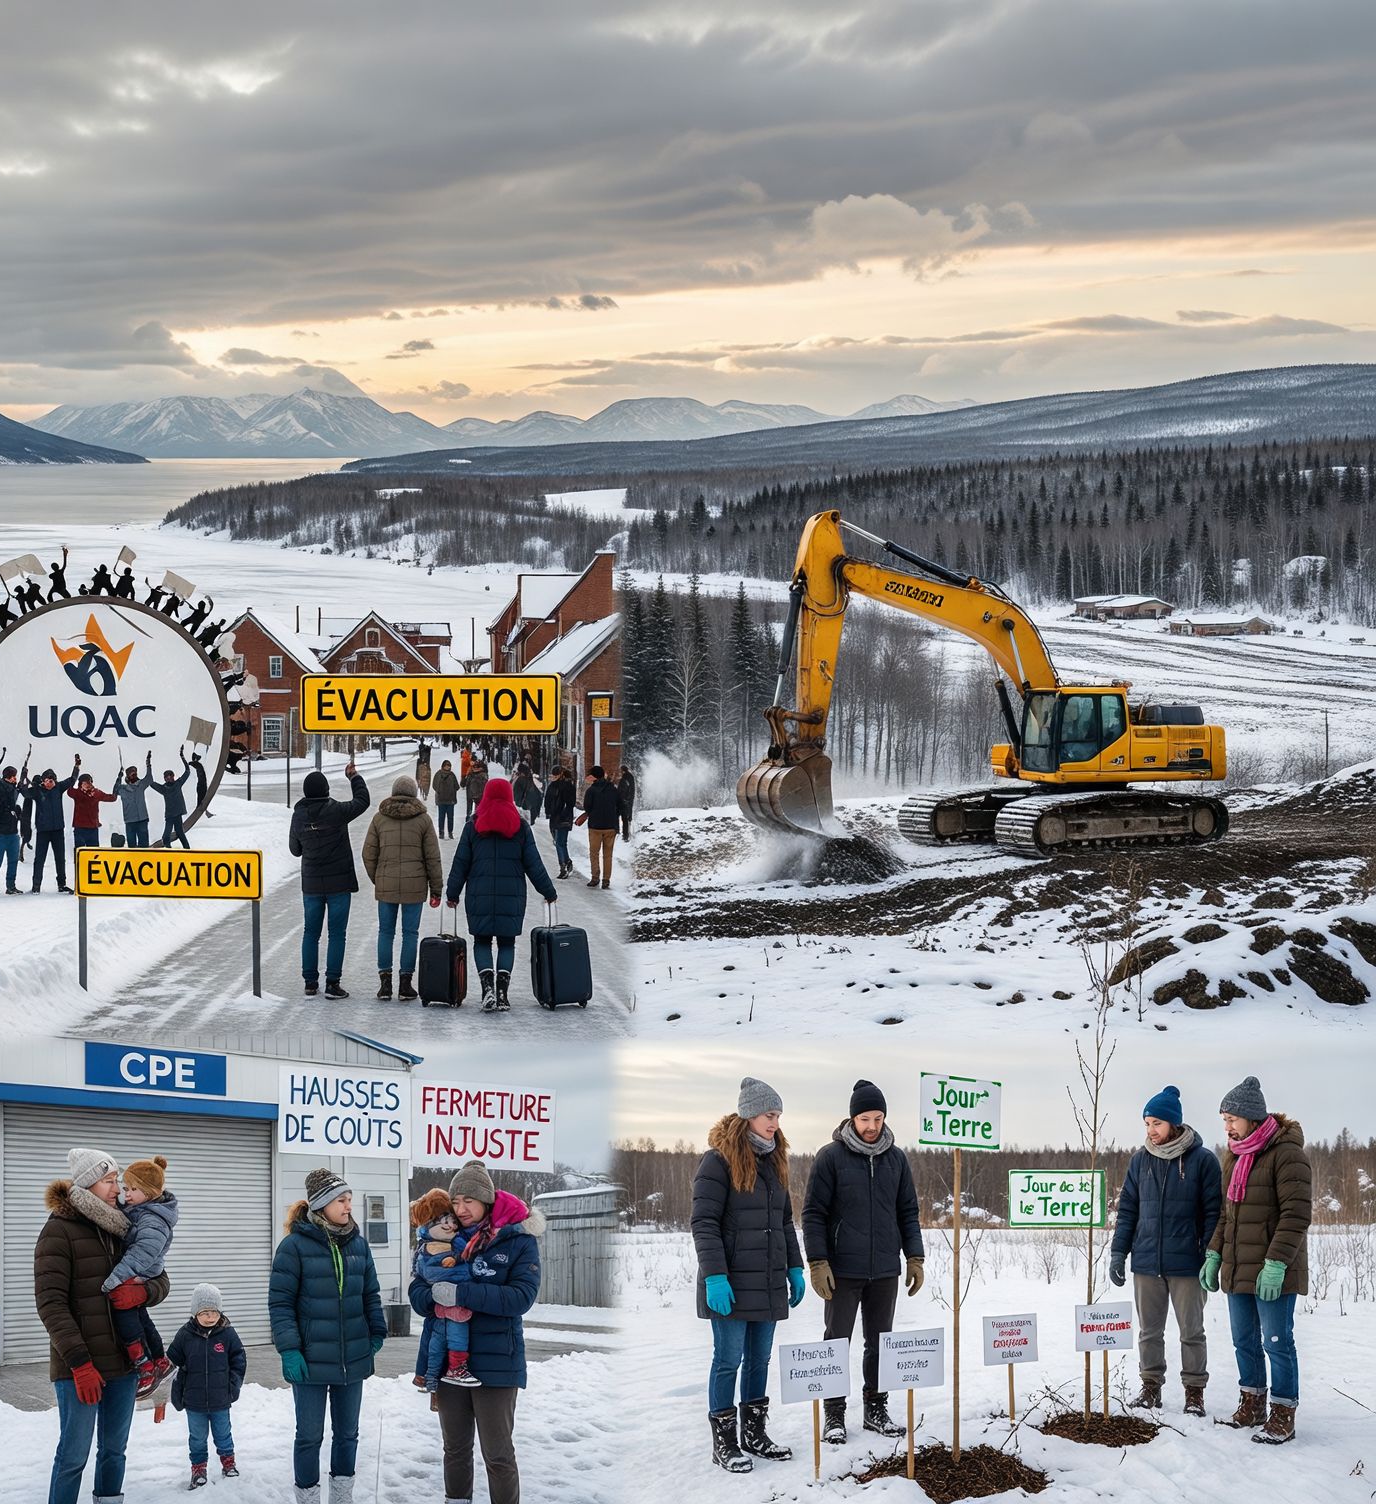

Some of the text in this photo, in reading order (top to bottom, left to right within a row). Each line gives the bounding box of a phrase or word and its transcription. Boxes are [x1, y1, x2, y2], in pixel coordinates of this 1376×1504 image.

[316, 680, 544, 721] ÉVACUATION
[28, 705, 157, 746] UQAC
[87, 854, 251, 888] ÉVACUATION
[119, 1051, 197, 1090] CPE
[289, 1074, 400, 1111] HAUSSES
[422, 1086, 551, 1124] FERMETURE
[284, 1111, 403, 1149] DE COÛTS
[426, 1123, 540, 1162] INJUSTE
[936, 1110, 993, 1140] Terre
[1020, 1175, 1057, 1193] Jour
[1037, 1196, 1091, 1217] Terre
